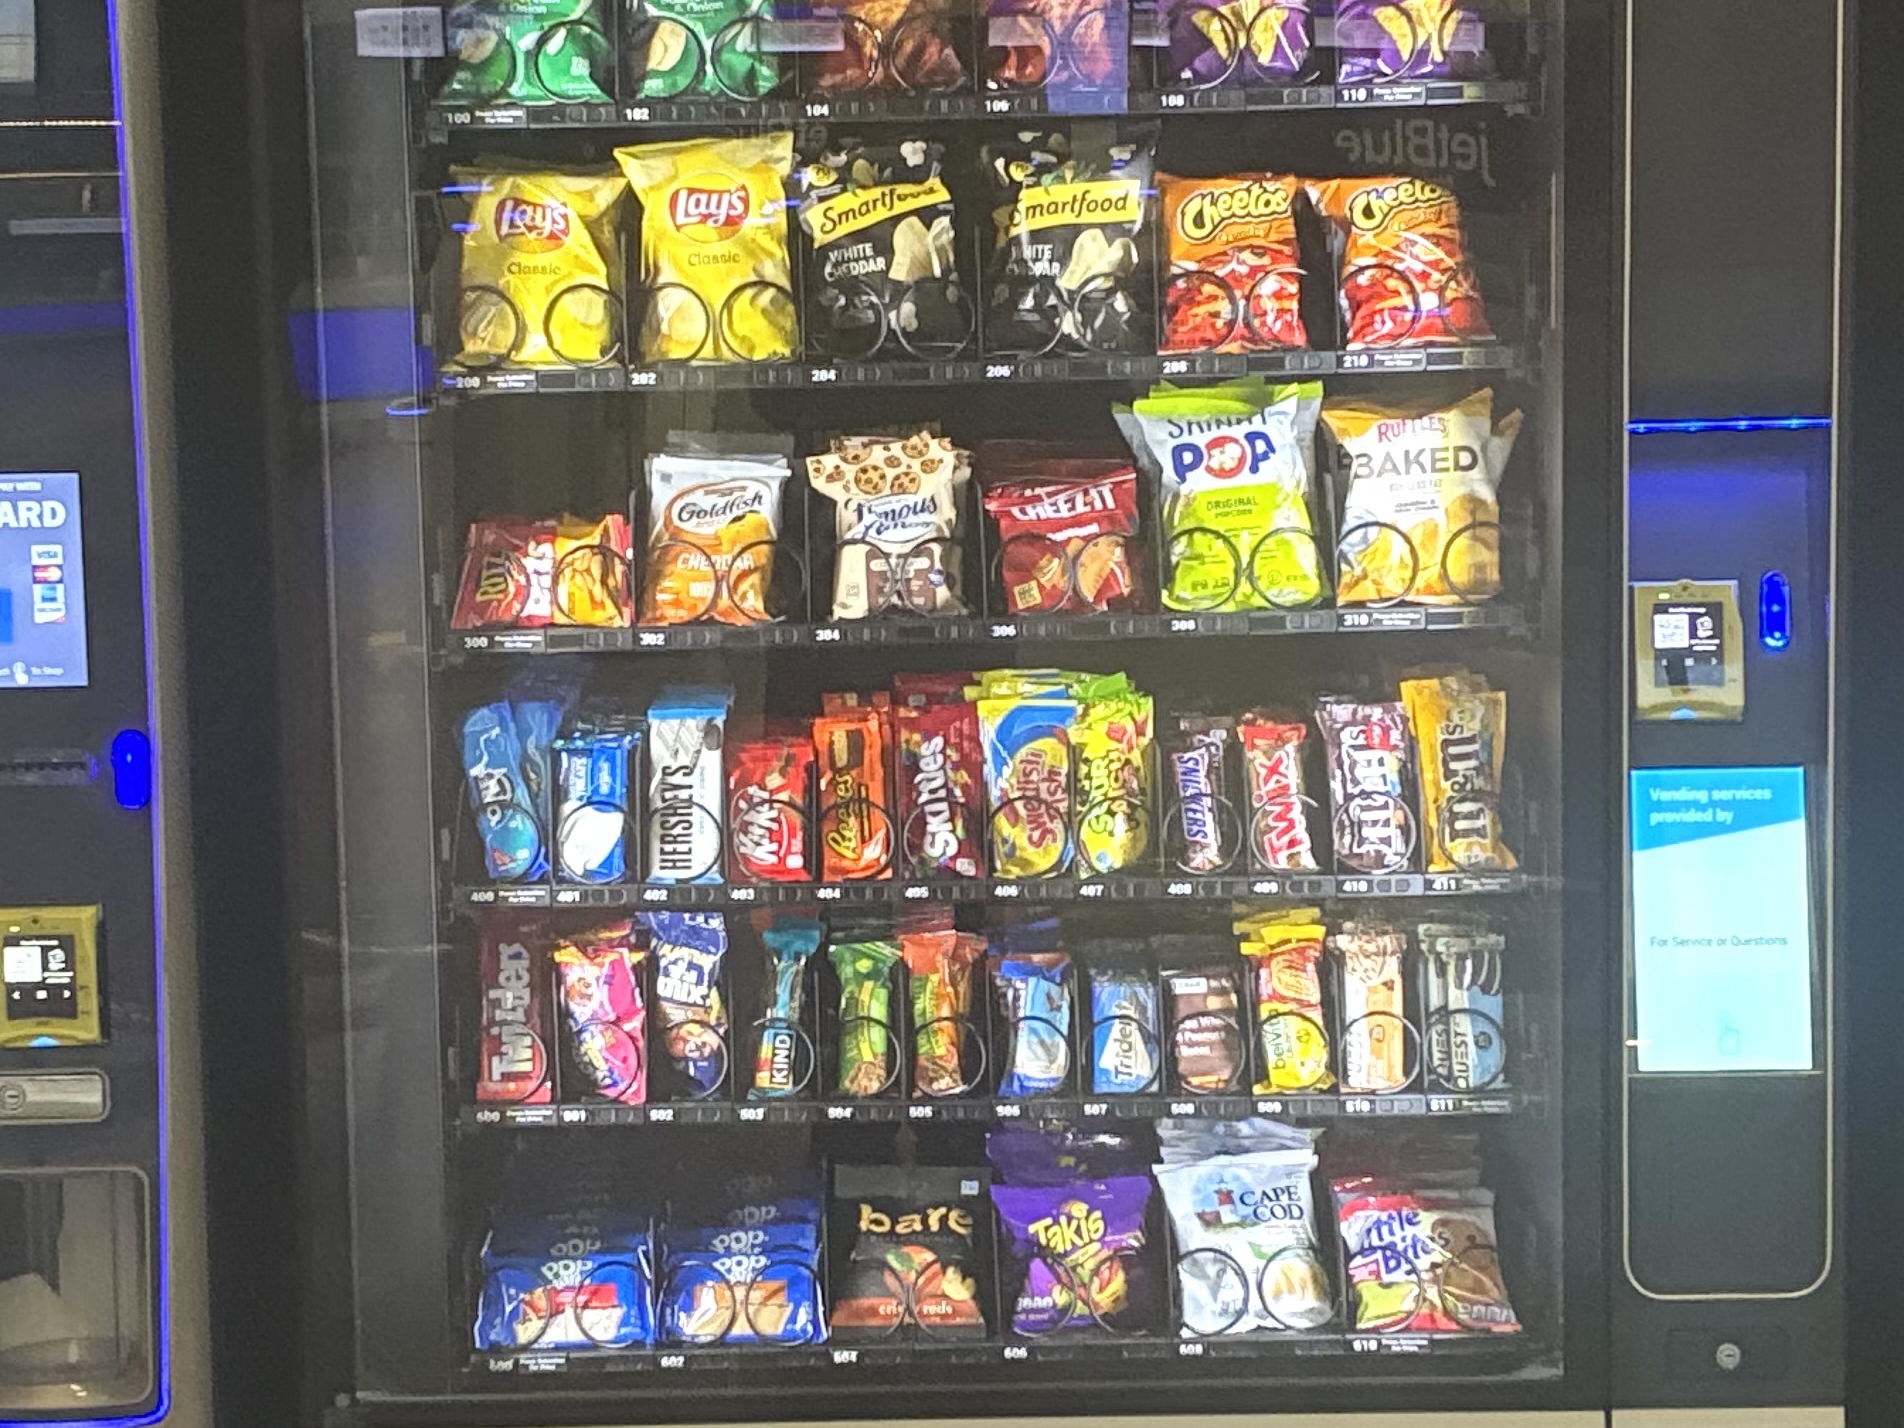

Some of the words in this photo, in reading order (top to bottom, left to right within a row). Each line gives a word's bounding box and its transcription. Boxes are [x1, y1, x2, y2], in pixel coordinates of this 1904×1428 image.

[1160, 93, 1184, 108] 108
[1342, 88, 1366, 101] 110
[626, 107, 649, 120] 102
[806, 105, 829, 118] 104
[674, 183, 747, 227] Lay's
[819, 182, 939, 235] Smartfood
[1180, 183, 1291, 236] Cheetos
[1348, 178, 1454, 232] Cheetos
[497, 196, 569, 238] Lay's
[688, 250, 741, 266] Classic
[829, 242, 874, 263] WHITE
[507, 260, 562, 276] Classic
[825, 256, 887, 279] CHEDDAR
[1343, 354, 1368, 367] 210
[811, 369, 836, 382] 204
[986, 364, 1010, 378] 206
[631, 372, 656, 386] 202
[1377, 415, 1448, 443] RUFFLES
[1171, 431, 1276, 485] POP
[1352, 444, 1480, 480] BAKED
[677, 491, 765, 524] Goldfish
[1171, 618, 1196, 632] 308
[1343, 613, 1369, 627] 310
[640, 632, 665, 645] 302
[816, 628, 840, 641] 304
[992, 625, 1017, 638] 306
[1017, 748, 1058, 849] Swedish
[1088, 757, 1116, 838] SOUR
[1177, 753, 1209, 842] SNICKERS
[1649, 786, 1709, 805] Vending
[1711, 785, 1772, 801] services
[659, 763, 694, 872] HERSHEY'S
[1650, 808, 1713, 825] provided
[1715, 807, 1735, 825] by
[994, 884, 1018, 898] 406
[1079, 884, 1104, 897] 407
[1254, 881, 1279, 894] 409
[1343, 879, 1368, 893] 410
[1432, 878, 1457, 891] 411
[557, 890, 581, 903] 401
[644, 889, 668, 902] 402
[731, 888, 755, 901] 403
[818, 887, 842, 900] 404
[904, 886, 929, 899] 405
[1650, 936, 1671, 948] For
[1672, 936, 1713, 948] Service
[1716, 938, 1728, 947] or
[1113, 1000, 1137, 1082] Trident
[772, 1034, 791, 1085] KIND
[1453, 1021, 1471, 1090] QUEST
[1084, 1103, 1108, 1115] 507
[1345, 1100, 1370, 1113] 510
[1430, 1099, 1454, 1112] 511
[649, 1109, 674, 1122] 502
[740, 1108, 764, 1121] 503
[1239, 1185, 1302, 1207] CAPE
[858, 1203, 974, 1235] bare
[1252, 1202, 1305, 1224] COD
[1028, 1210, 1106, 1256] Takis
[1352, 1338, 1378, 1352] 610
[833, 1351, 858, 1365] 604
[1003, 1346, 1028, 1360] 606
[660, 1355, 685, 1369] 602
